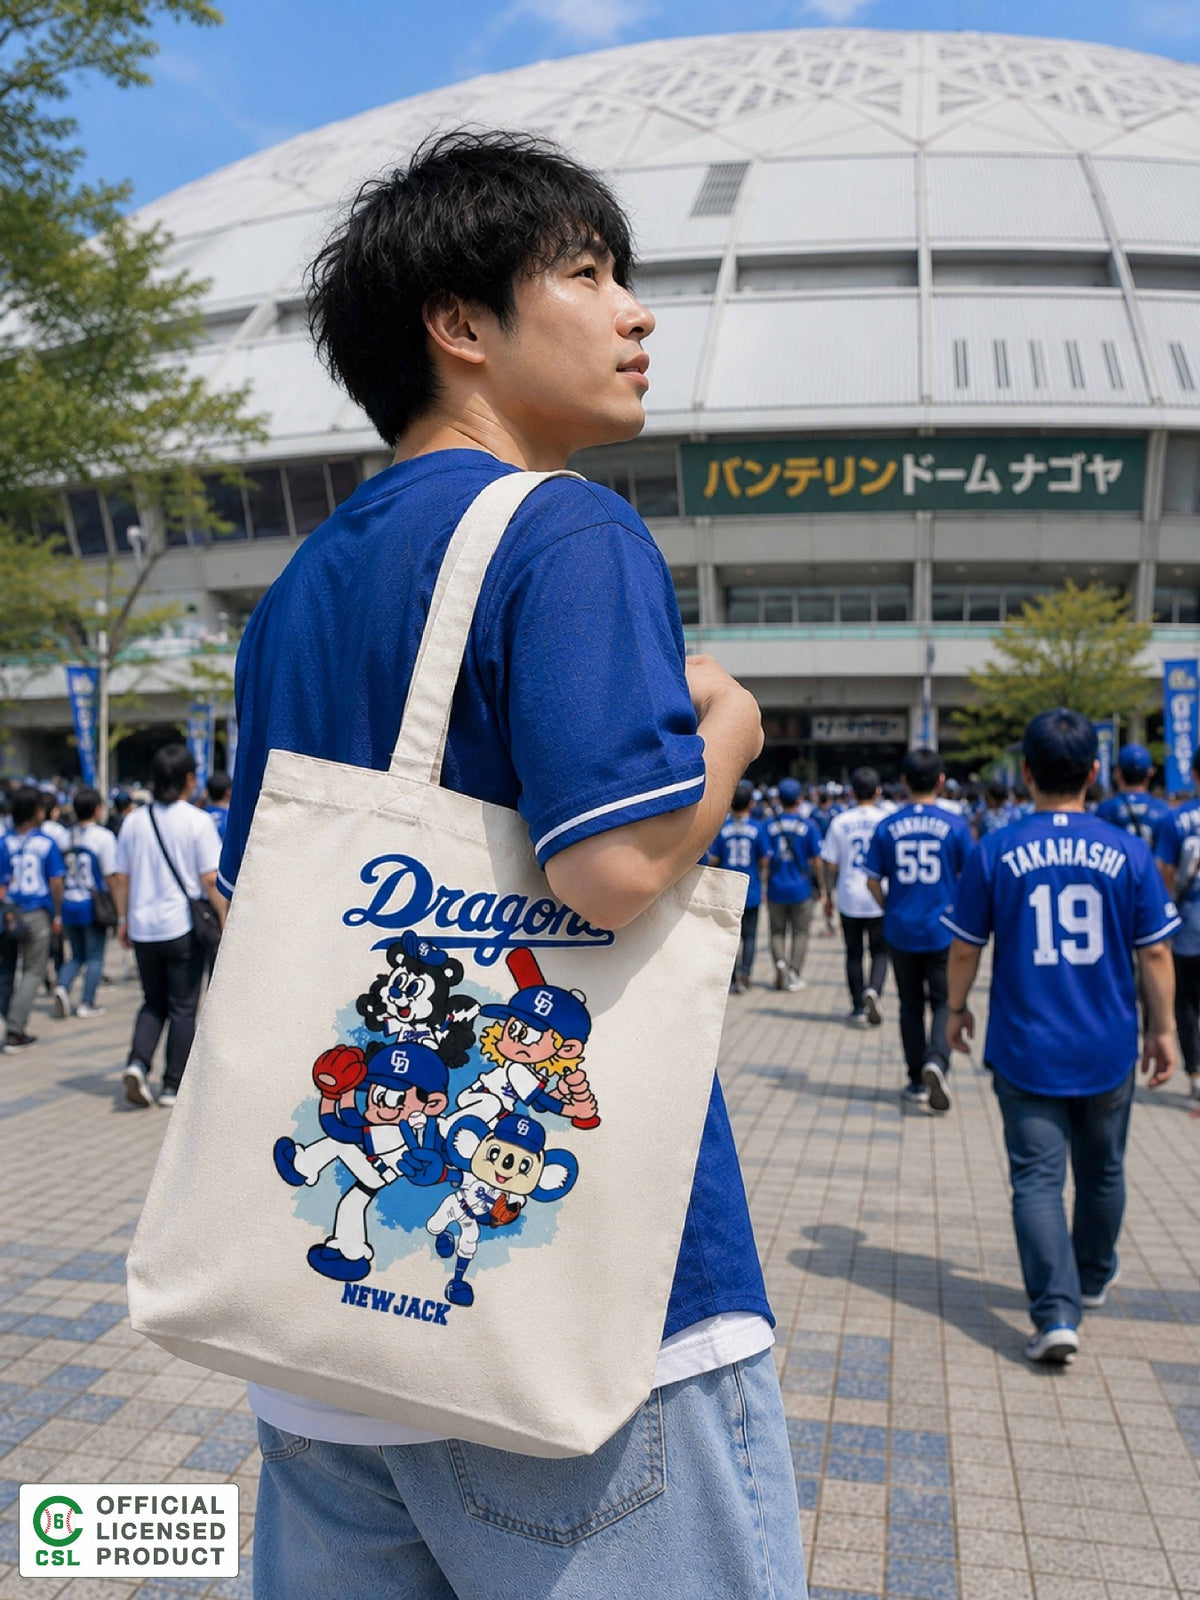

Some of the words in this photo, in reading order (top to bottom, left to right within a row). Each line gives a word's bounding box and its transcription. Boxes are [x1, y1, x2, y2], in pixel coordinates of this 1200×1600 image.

[1008, 451, 1123, 494] ナゴヤ
[895, 839, 941, 884] 55
[1001, 838, 1126, 879] TAKAHASHI
[1029, 883, 1104, 966] 19
